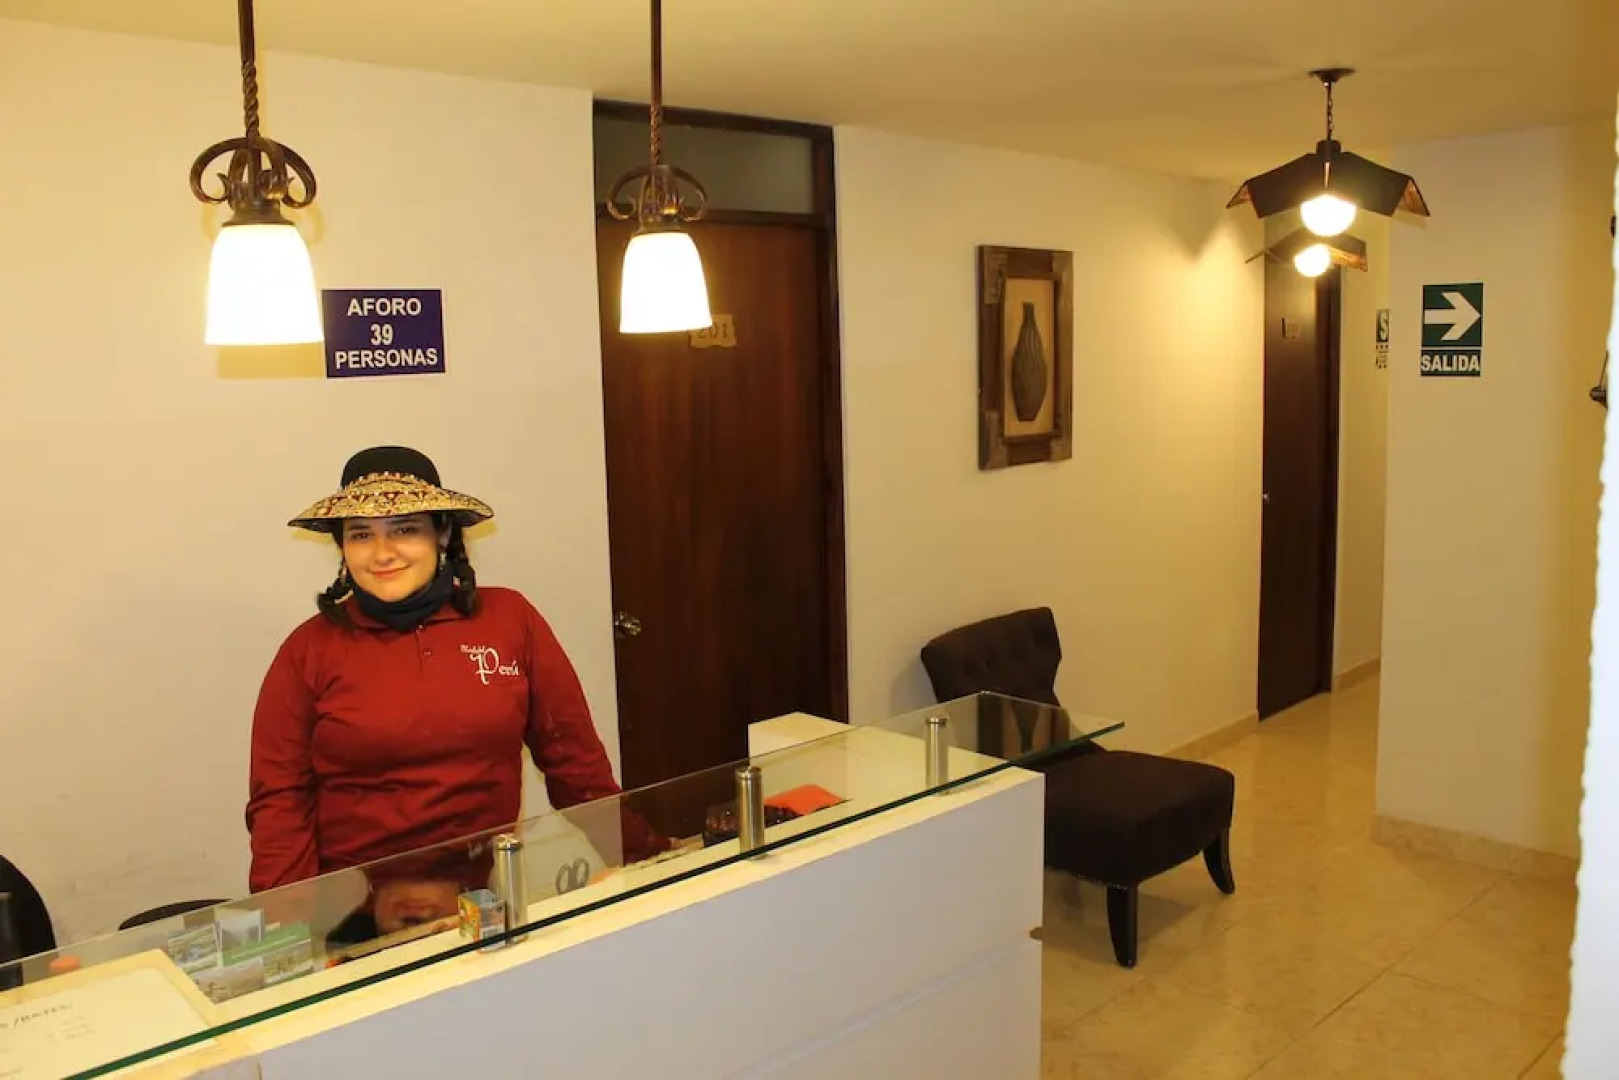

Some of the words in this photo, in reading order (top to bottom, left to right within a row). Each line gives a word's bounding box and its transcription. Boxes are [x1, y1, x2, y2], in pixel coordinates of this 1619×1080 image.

[347, 297, 422, 317] AFORO
[370, 323, 394, 346] 39
[697, 323, 728, 339] 201
[335, 347, 438, 369] PERSONAS
[1421, 354, 1480, 372] SALIDA
